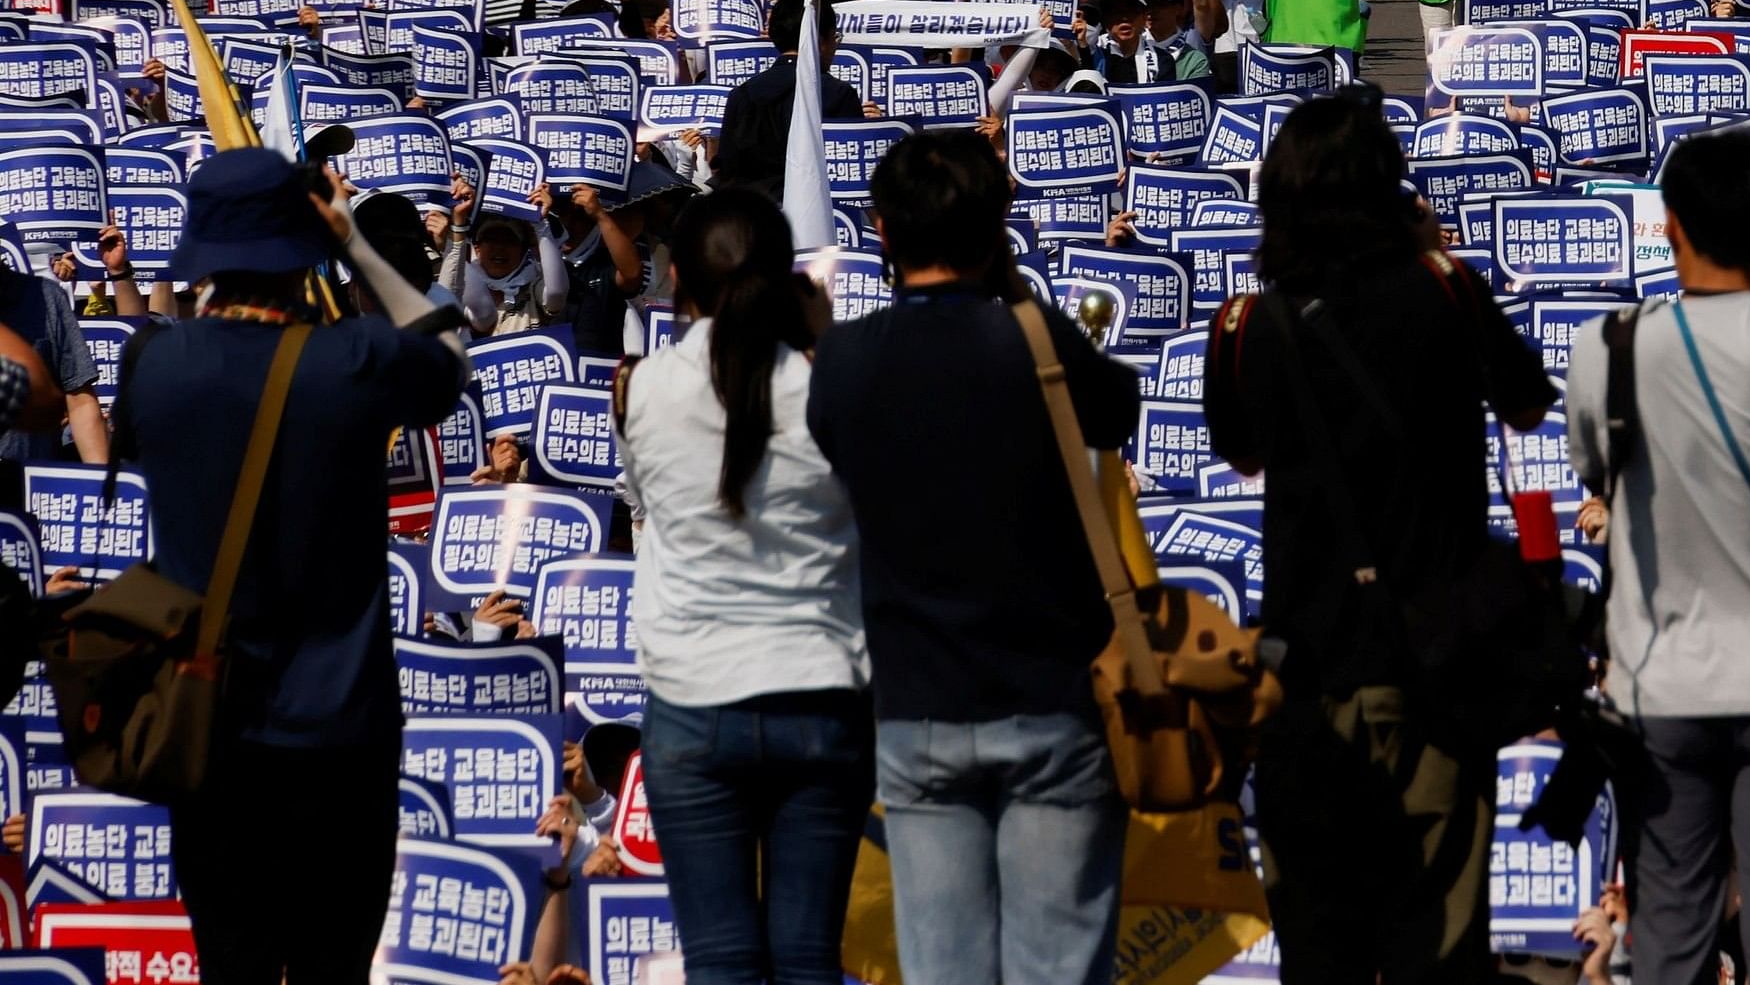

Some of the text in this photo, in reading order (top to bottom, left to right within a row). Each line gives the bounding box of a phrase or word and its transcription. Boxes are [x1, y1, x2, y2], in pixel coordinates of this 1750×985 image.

[910, 12, 1029, 35] 살리겠습니다!
[1488, 41, 1535, 61] 교육농단
[1157, 101, 1201, 123] 교육농단
[402, 135, 448, 157] 교육농단
[538, 131, 625, 153] 의료농단 교육농단
[1015, 125, 1111, 150] 의료농단 교육농단
[491, 155, 536, 176] 교육농단
[585, 152, 625, 173] 붕괴된다
[1015, 146, 1114, 172] 필수의료 붕괴된다
[0, 169, 98, 191] 의료농단 교육농단
[486, 171, 533, 194] 붕괴된다
[0, 191, 99, 214] 필수의료 붕괴된다
[1135, 186, 1183, 207] 의료농단
[1506, 220, 1560, 241] 의료농단
[1564, 218, 1618, 239] 교육농단
[1507, 242, 1619, 264] 필수의료 붕괴된다
[502, 355, 561, 383] 교육농단
[1149, 424, 1210, 448] 의료농단
[398, 668, 548, 705] 의료농단 교육농단
[454, 749, 538, 783] 교육농단
[454, 784, 538, 819] 붕괴된다
[45, 824, 128, 859] 의료농단
[1491, 840, 1575, 874] 교육농단
[414, 875, 511, 923] 교육농단
[409, 914, 506, 965] 붕괴된다
[606, 916, 679, 953] 의료농
